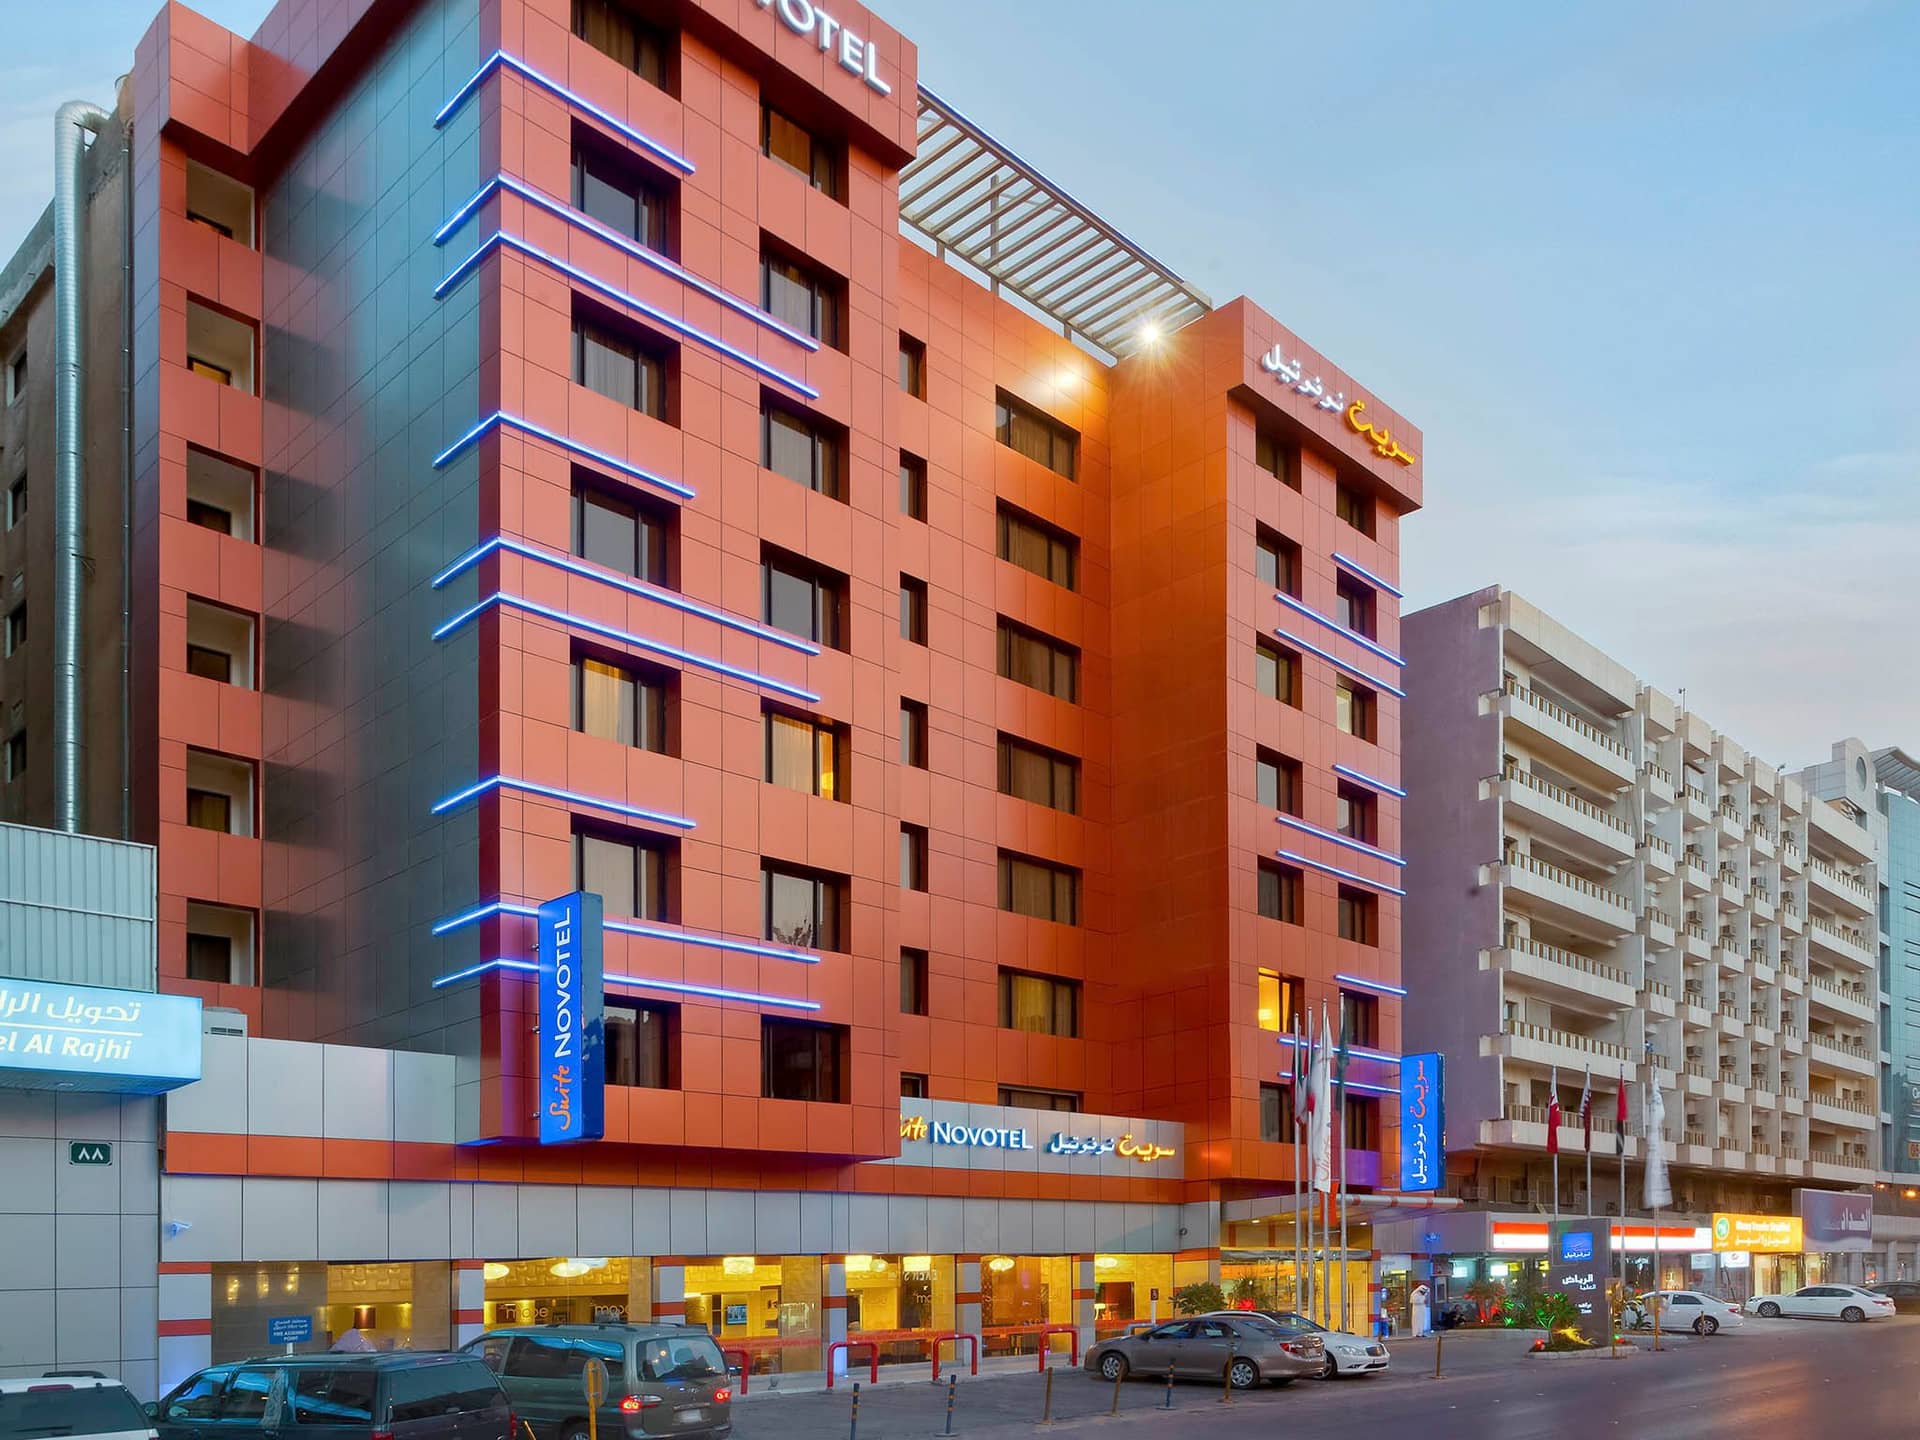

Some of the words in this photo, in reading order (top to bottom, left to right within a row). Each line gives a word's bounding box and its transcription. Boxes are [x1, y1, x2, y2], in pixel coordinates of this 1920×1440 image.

[757, 0, 892, 96] OTEL
[1262, 344, 1344, 413] نوفوتيل
[1348, 400, 1415, 465] سويت
[554, 906, 571, 1059] NOVOTEL
[46, 995, 141, 1025] تحويل
[23, 1033, 53, 1055] Al
[61, 1036, 132, 1063] Rajhi
[549, 1065, 572, 1131] Suite
[932, 1121, 1033, 1150] NOVOTEL
[1050, 1132, 1115, 1155] نوفوتيل
[1119, 1133, 1176, 1161] سويت
